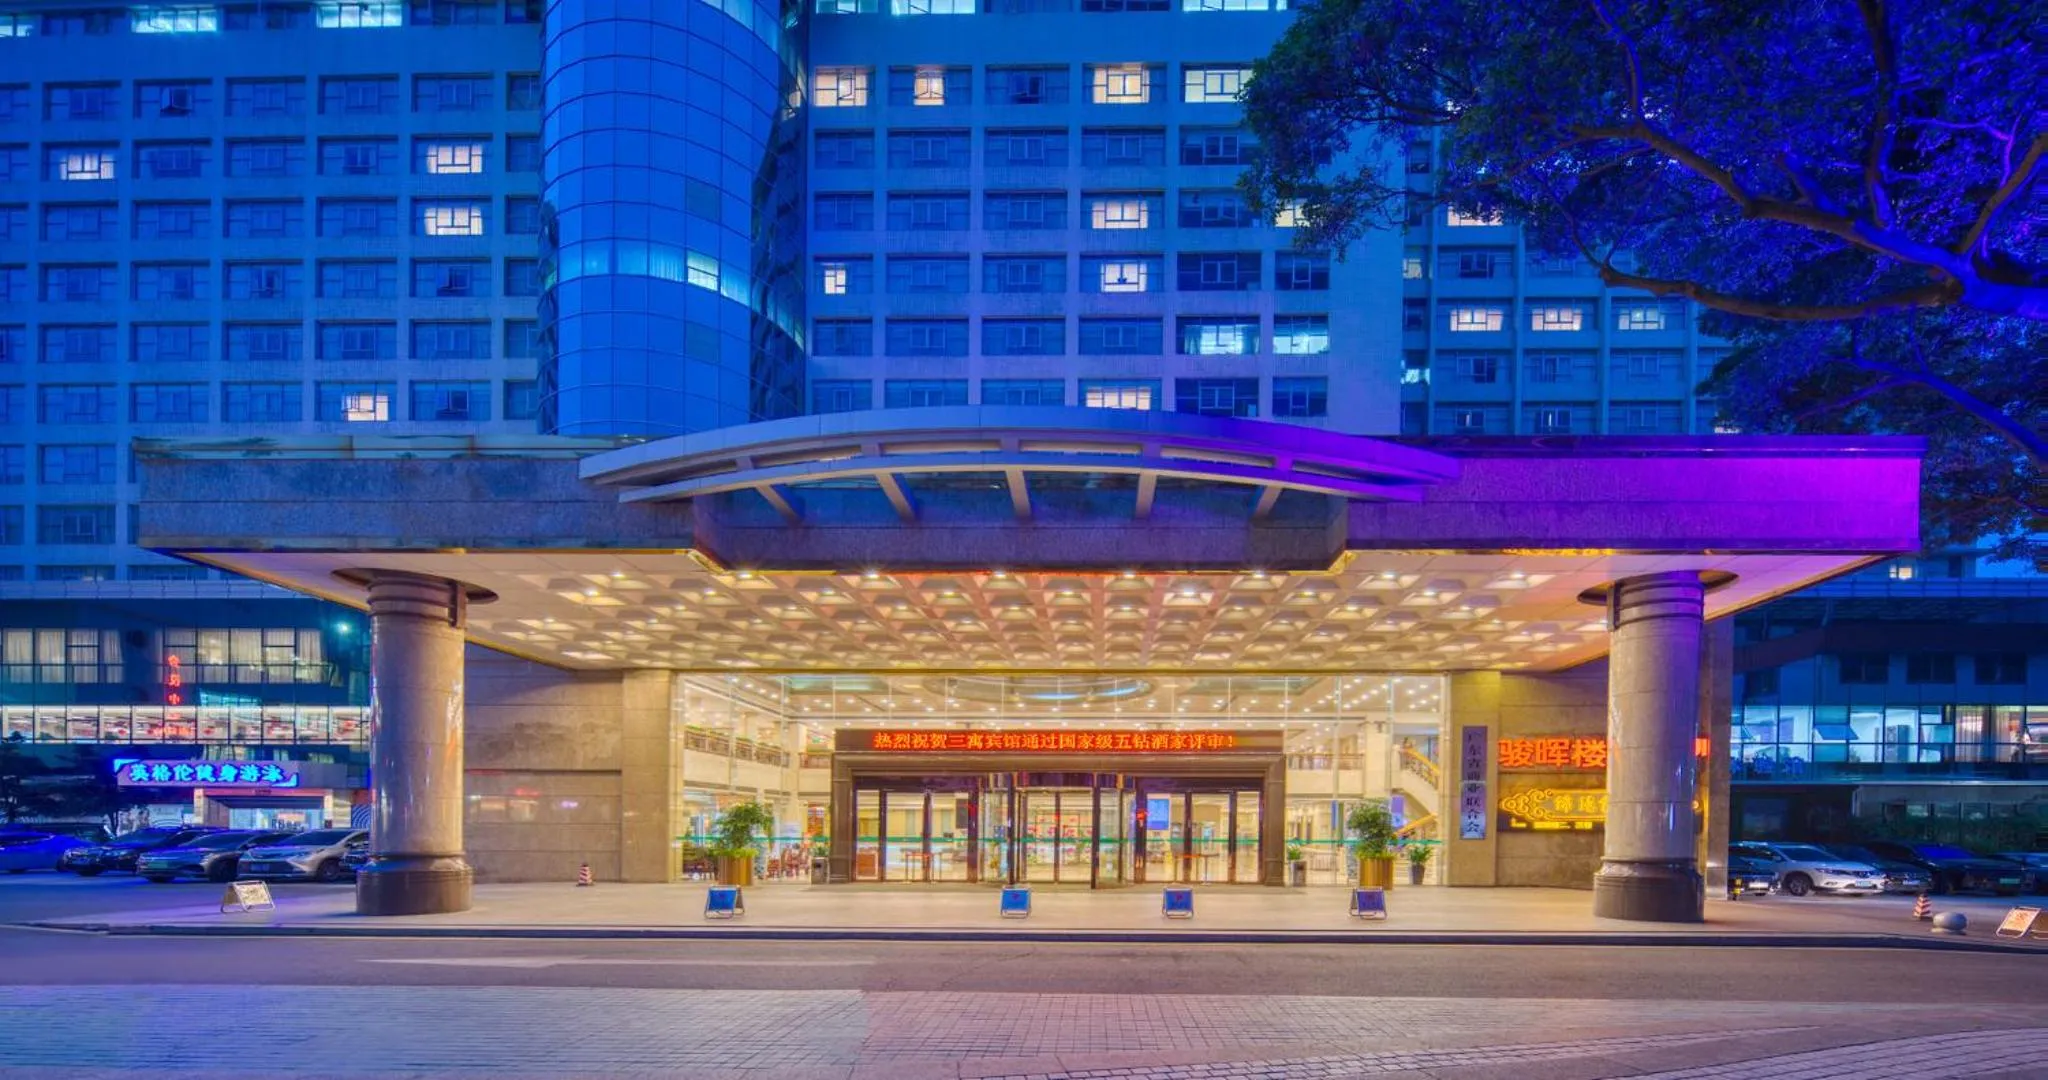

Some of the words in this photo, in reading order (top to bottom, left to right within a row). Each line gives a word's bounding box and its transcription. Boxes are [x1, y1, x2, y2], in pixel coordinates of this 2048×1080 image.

[1498, 737, 1607, 767] 骏晖楼
[129, 763, 284, 782] 英格伦健身游泳
